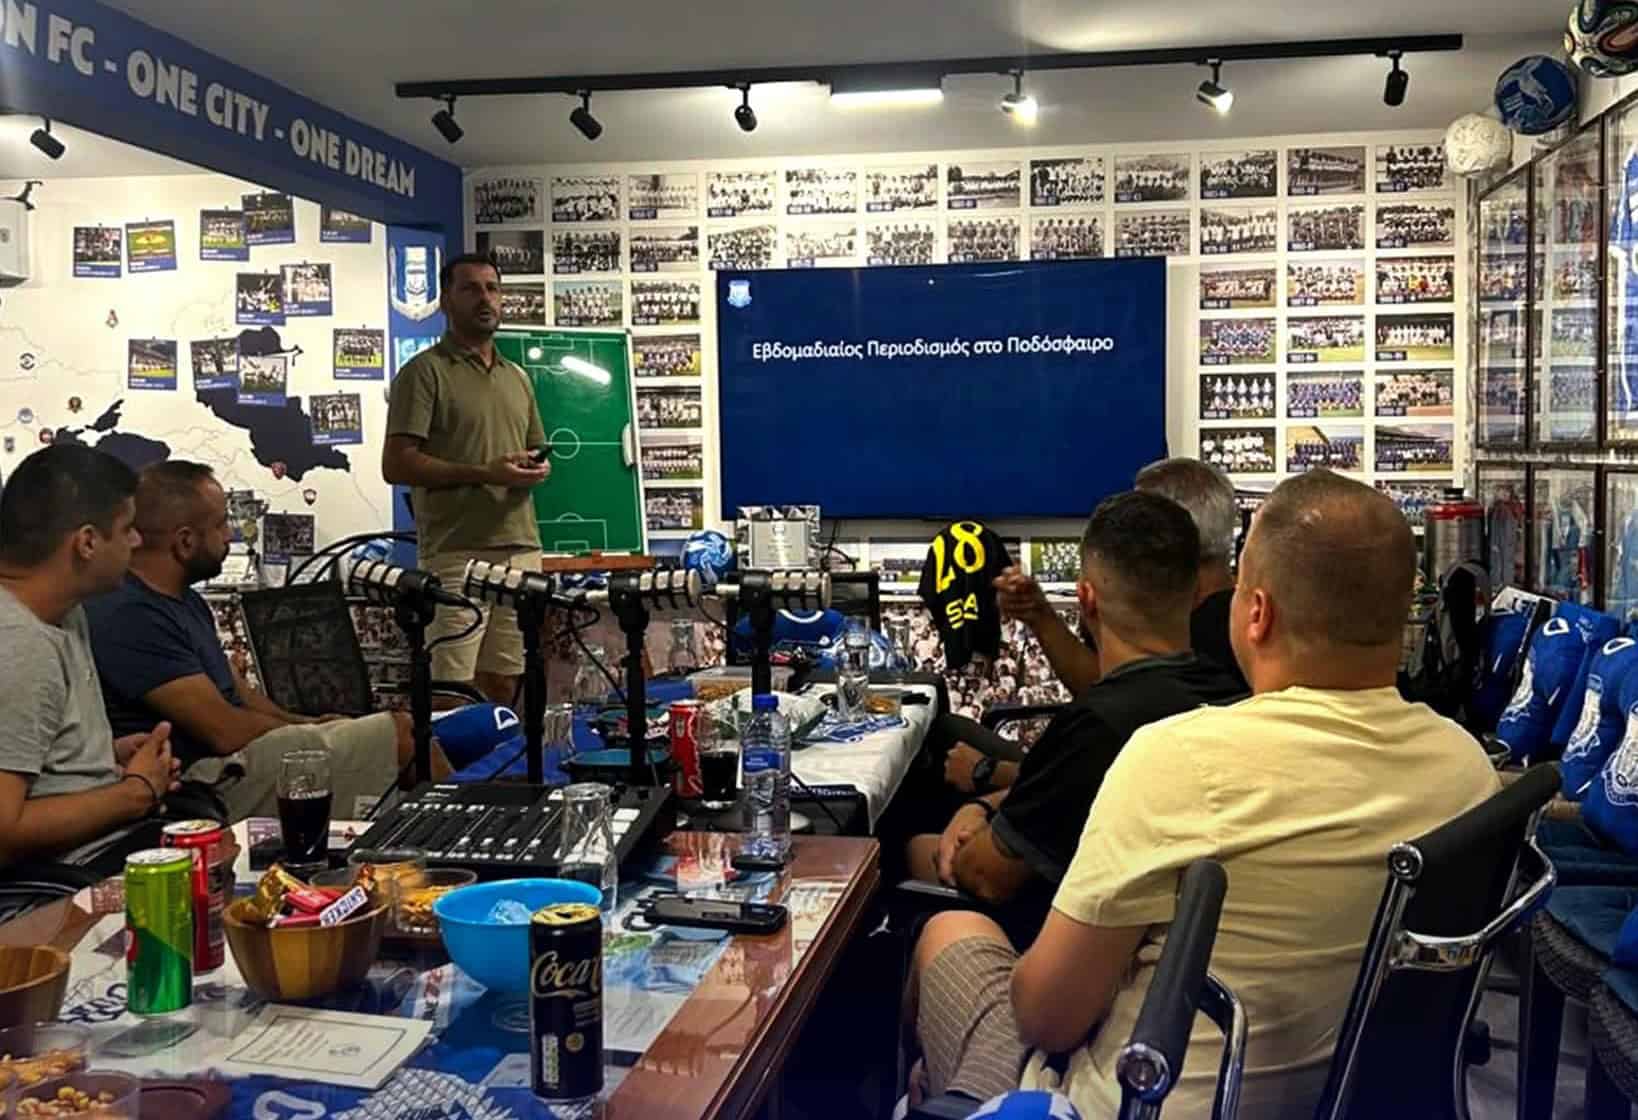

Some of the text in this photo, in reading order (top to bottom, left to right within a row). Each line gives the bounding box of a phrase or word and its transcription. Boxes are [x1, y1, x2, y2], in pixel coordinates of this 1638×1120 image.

[47, 14, 95, 76] FC
[127, 50, 197, 116] ONE
[205, 83, 270, 140] CITY
[291, 118, 340, 169] ONE
[345, 135, 415, 198] DREAM
[752, 334, 1114, 362] Εβδομαδιαίος Περιοδισμός στο Ποδόσφαιρο
